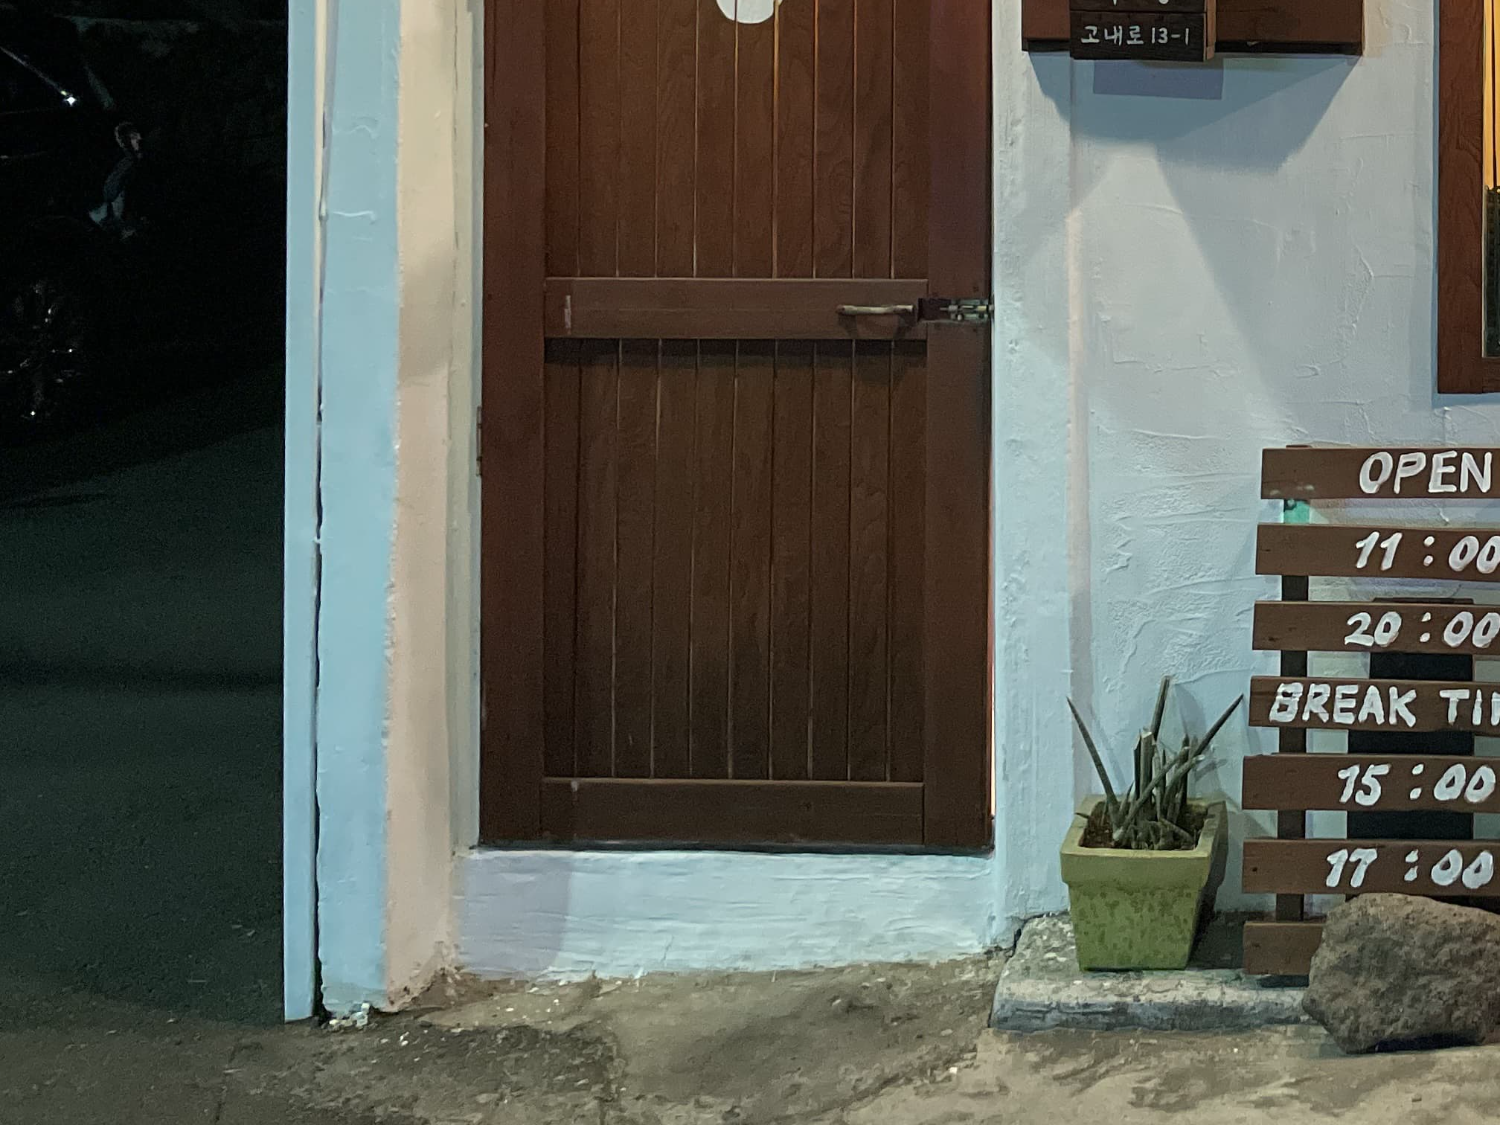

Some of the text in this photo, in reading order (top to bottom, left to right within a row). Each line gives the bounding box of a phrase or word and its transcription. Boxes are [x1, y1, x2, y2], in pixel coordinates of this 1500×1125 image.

[1080, 25, 1190, 46] 고내로 13-1
[1359, 451, 1493, 494] OPEN
[1268, 682, 1417, 728] BREAK
